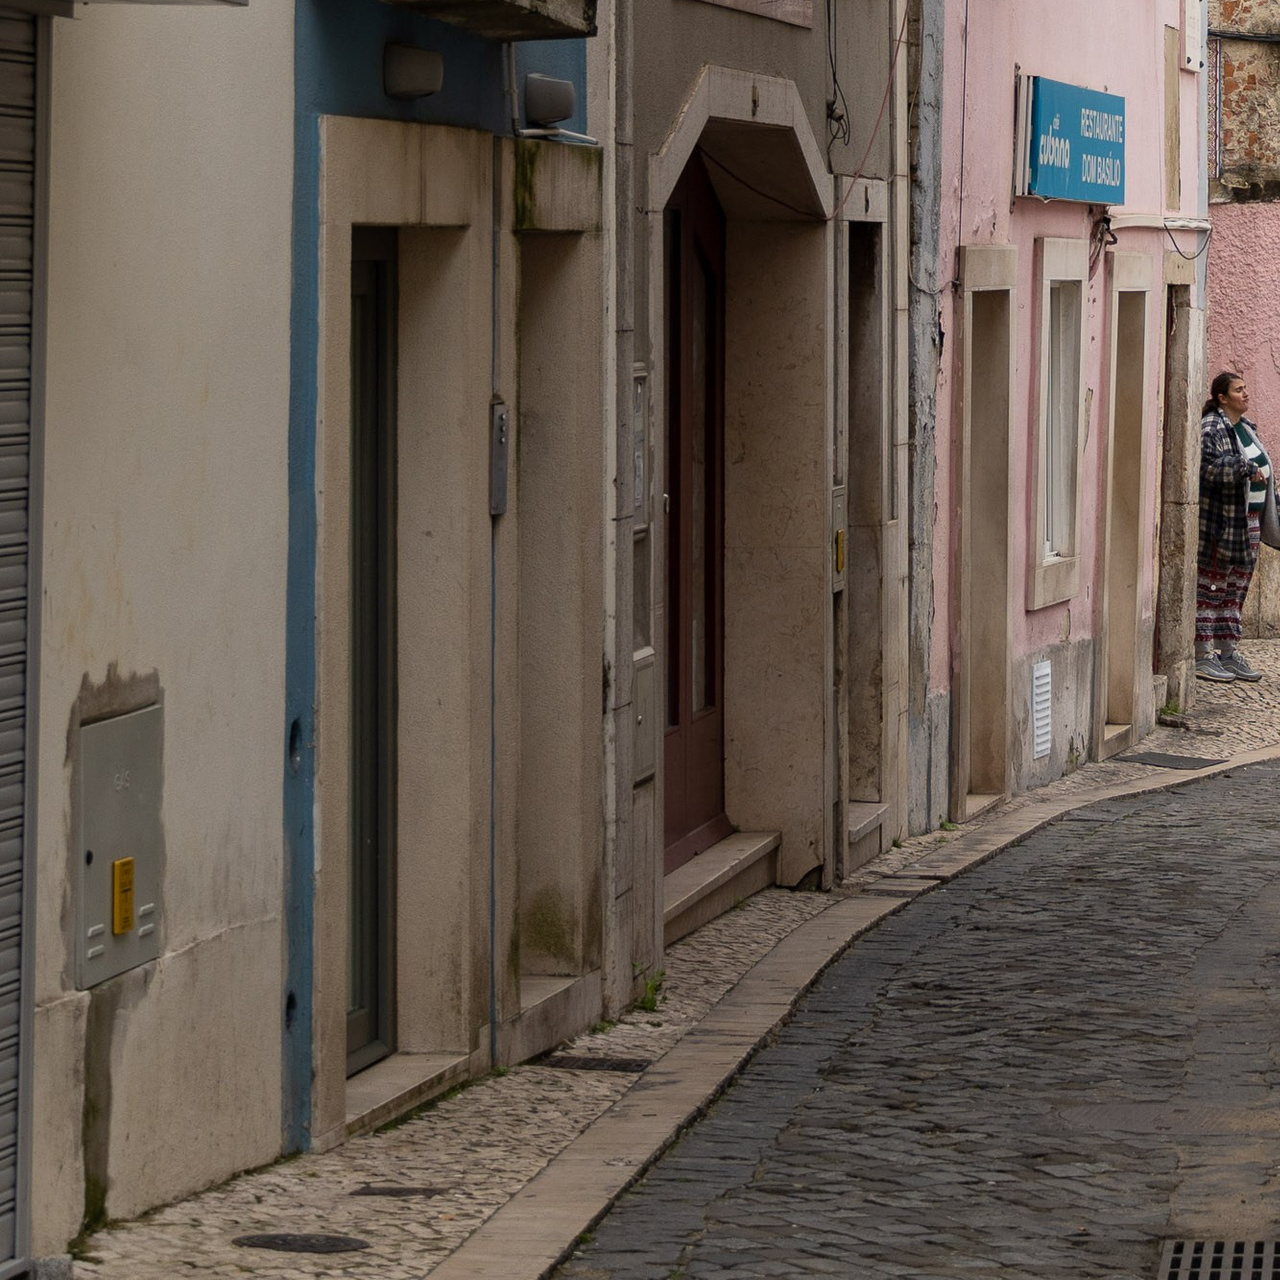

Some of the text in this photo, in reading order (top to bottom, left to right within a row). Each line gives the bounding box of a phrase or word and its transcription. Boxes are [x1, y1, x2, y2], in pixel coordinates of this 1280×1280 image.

[1080, 108, 1123, 143] RESTAURANTE
[1082, 151, 1121, 186] DOM BASÍLIO
